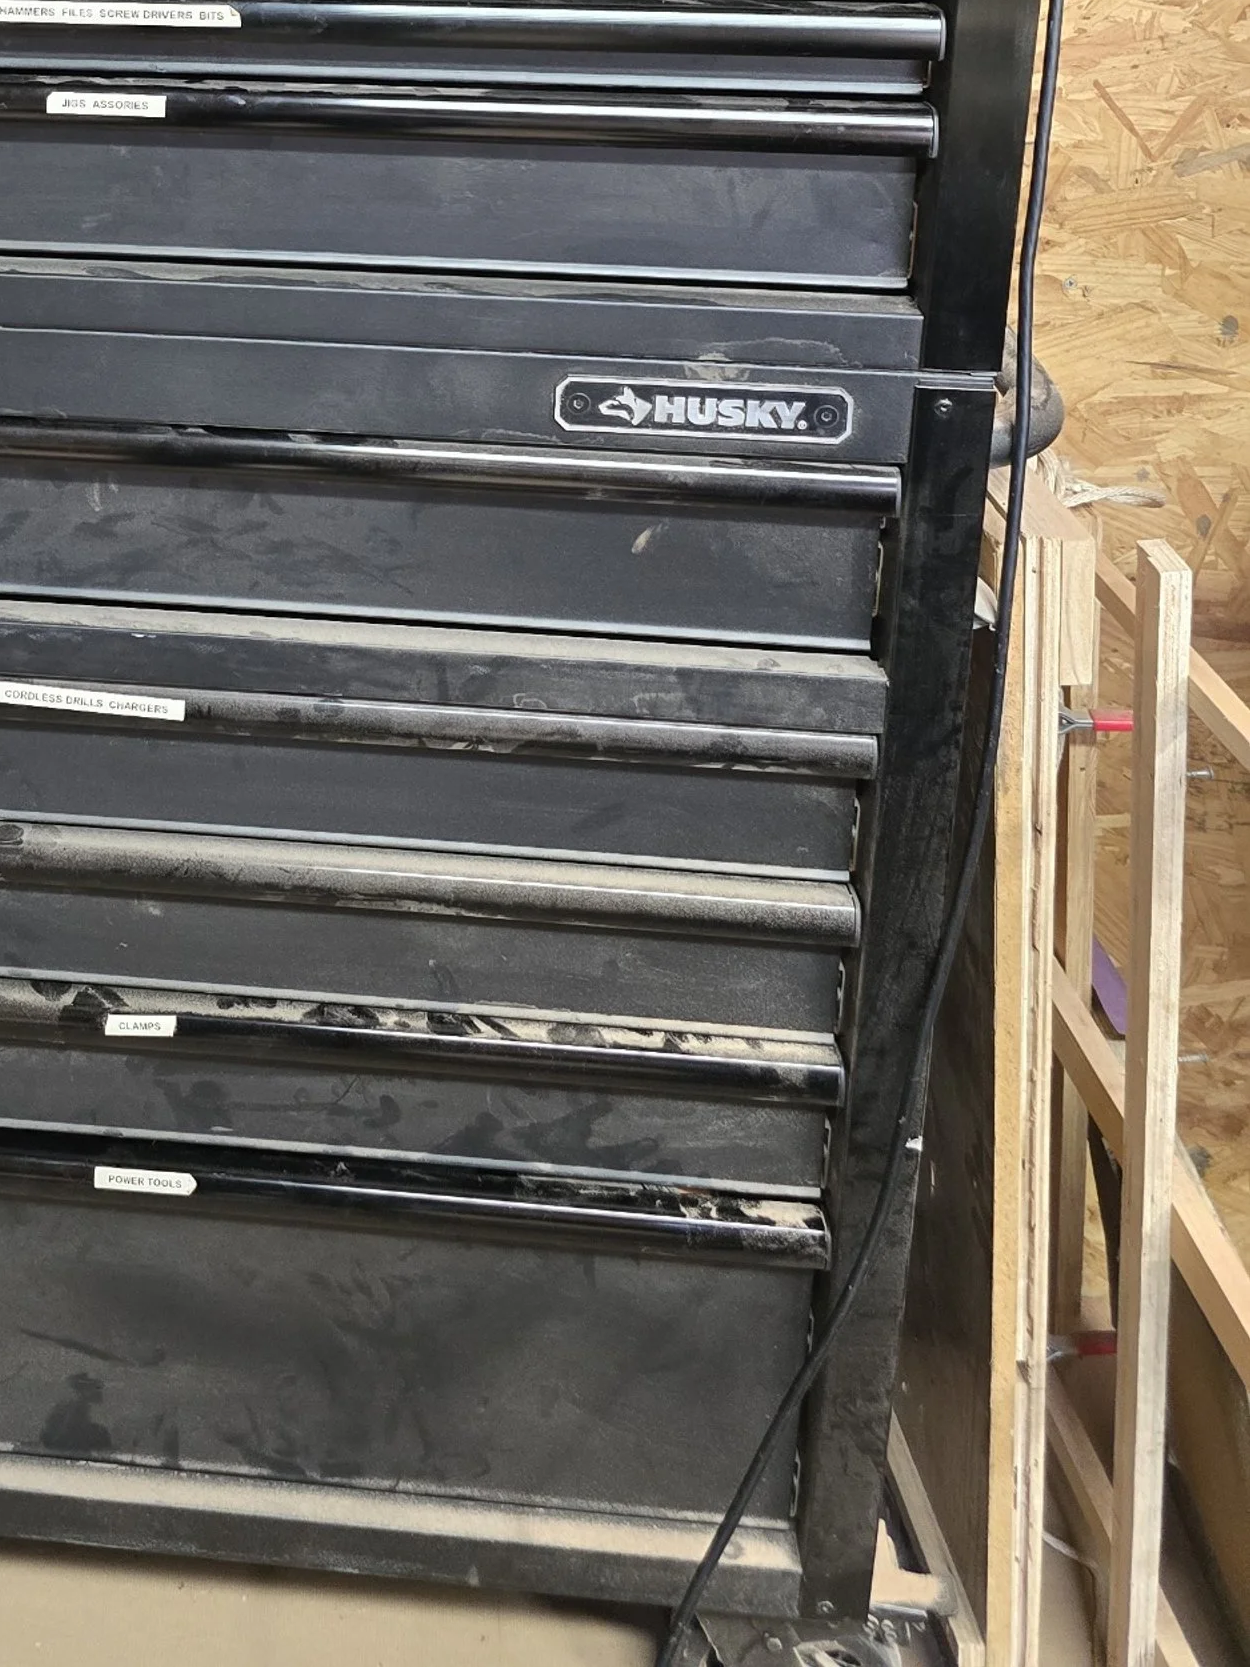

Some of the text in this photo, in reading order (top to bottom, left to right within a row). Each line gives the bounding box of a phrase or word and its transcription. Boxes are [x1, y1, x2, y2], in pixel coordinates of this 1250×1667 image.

[0, 6, 225, 21] HAMMERS FILES SCREW DRIVERS BITS
[61, 98, 150, 110] JIGS ASSORIES
[654, 395, 806, 430] HUSKY
[4, 689, 169, 714] CORDLESS DRILLS CHARGERS
[118, 1021, 162, 1032] CLAMPS
[108, 1174, 183, 1189] POWER TOOLS
